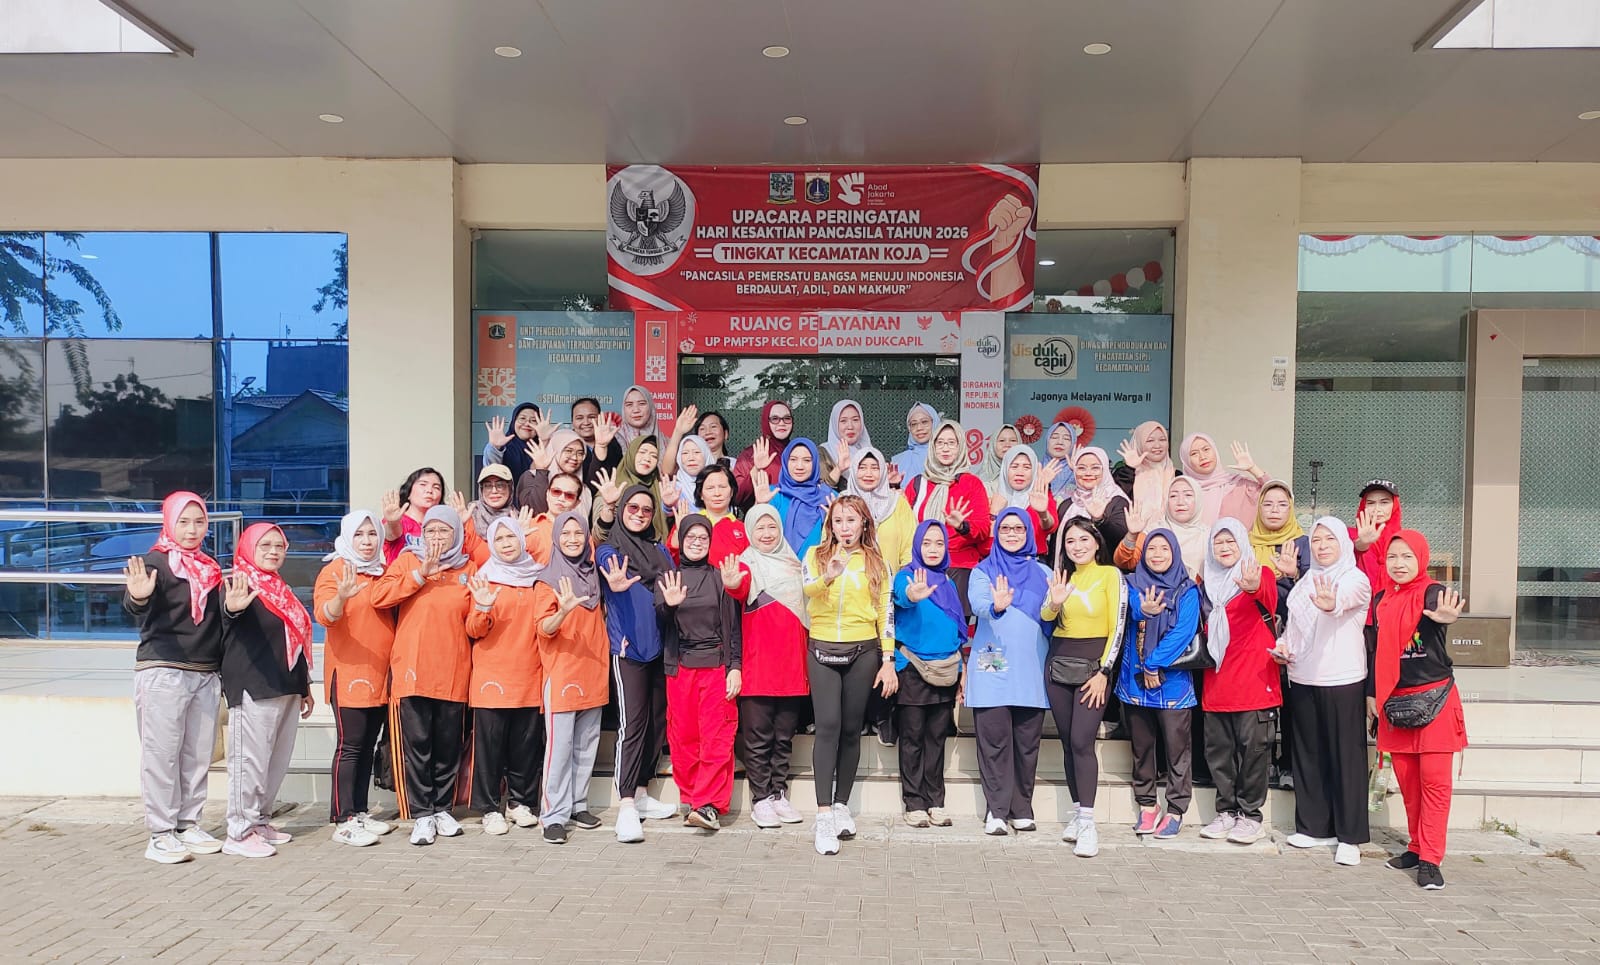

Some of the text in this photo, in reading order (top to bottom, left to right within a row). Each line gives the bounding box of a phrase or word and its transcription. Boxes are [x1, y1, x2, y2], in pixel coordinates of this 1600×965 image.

[867, 183, 888, 191] Abad
[867, 190, 895, 199] Jakarta
[732, 209, 920, 224] UPACARA PERINGATAN
[696, 226, 969, 239] HARI KESAKTIAN PANCASILA TAHUN 2026
[721, 246, 922, 260] TINGKAT KECAMATAN KOJA
[748, 271, 810, 281] PEMERSATU
[814, 271, 857, 281] BANGSA
[860, 271, 904, 281] MENUJU
[907, 271, 964, 281] INDONESIA
[737, 284, 800, 296] BERDAULAT,
[803, 284, 830, 296] ADIL,
[833, 284, 855, 294] DAN
[730, 316, 900, 331] RUANG PELAYANAN
[705, 336, 923, 347] UP PMPTSP KEC. KOJA DAN DUKCAPIL
[977, 345, 997, 356] capil
[1034, 354, 1067, 371] capil
[962, 381, 1002, 389] DIRGAHAYU
[965, 391, 999, 399] REPUBLIK
[1030, 391, 1068, 402] Jagonya
[1071, 392, 1111, 403] Melayani
[1113, 392, 1143, 403] Warga
[963, 401, 1001, 409] INDONESIA
